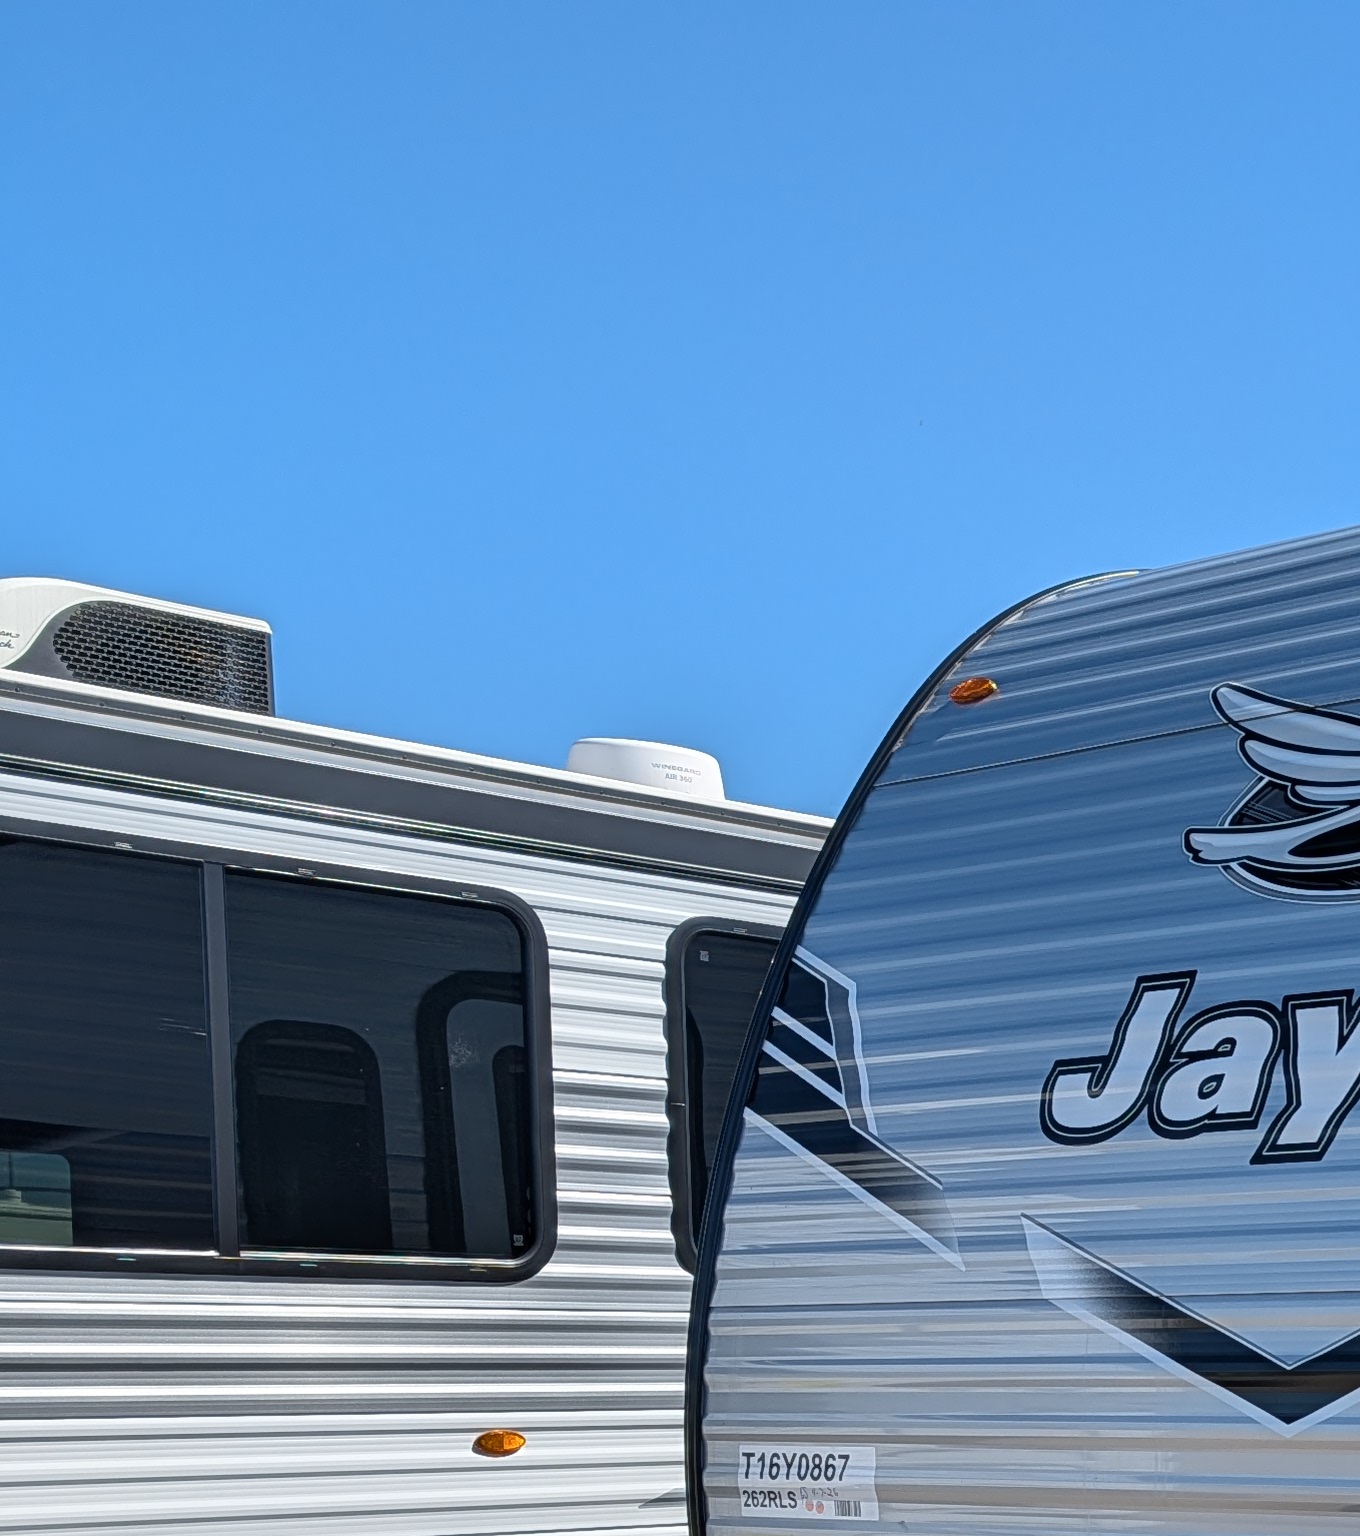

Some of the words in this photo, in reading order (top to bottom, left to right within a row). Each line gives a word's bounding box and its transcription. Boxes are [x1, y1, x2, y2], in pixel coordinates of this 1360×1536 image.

[651, 762, 702, 776] WINEGARD
[742, 1452, 850, 1481] T16Y0867
[742, 1490, 797, 1509] 262RLS
